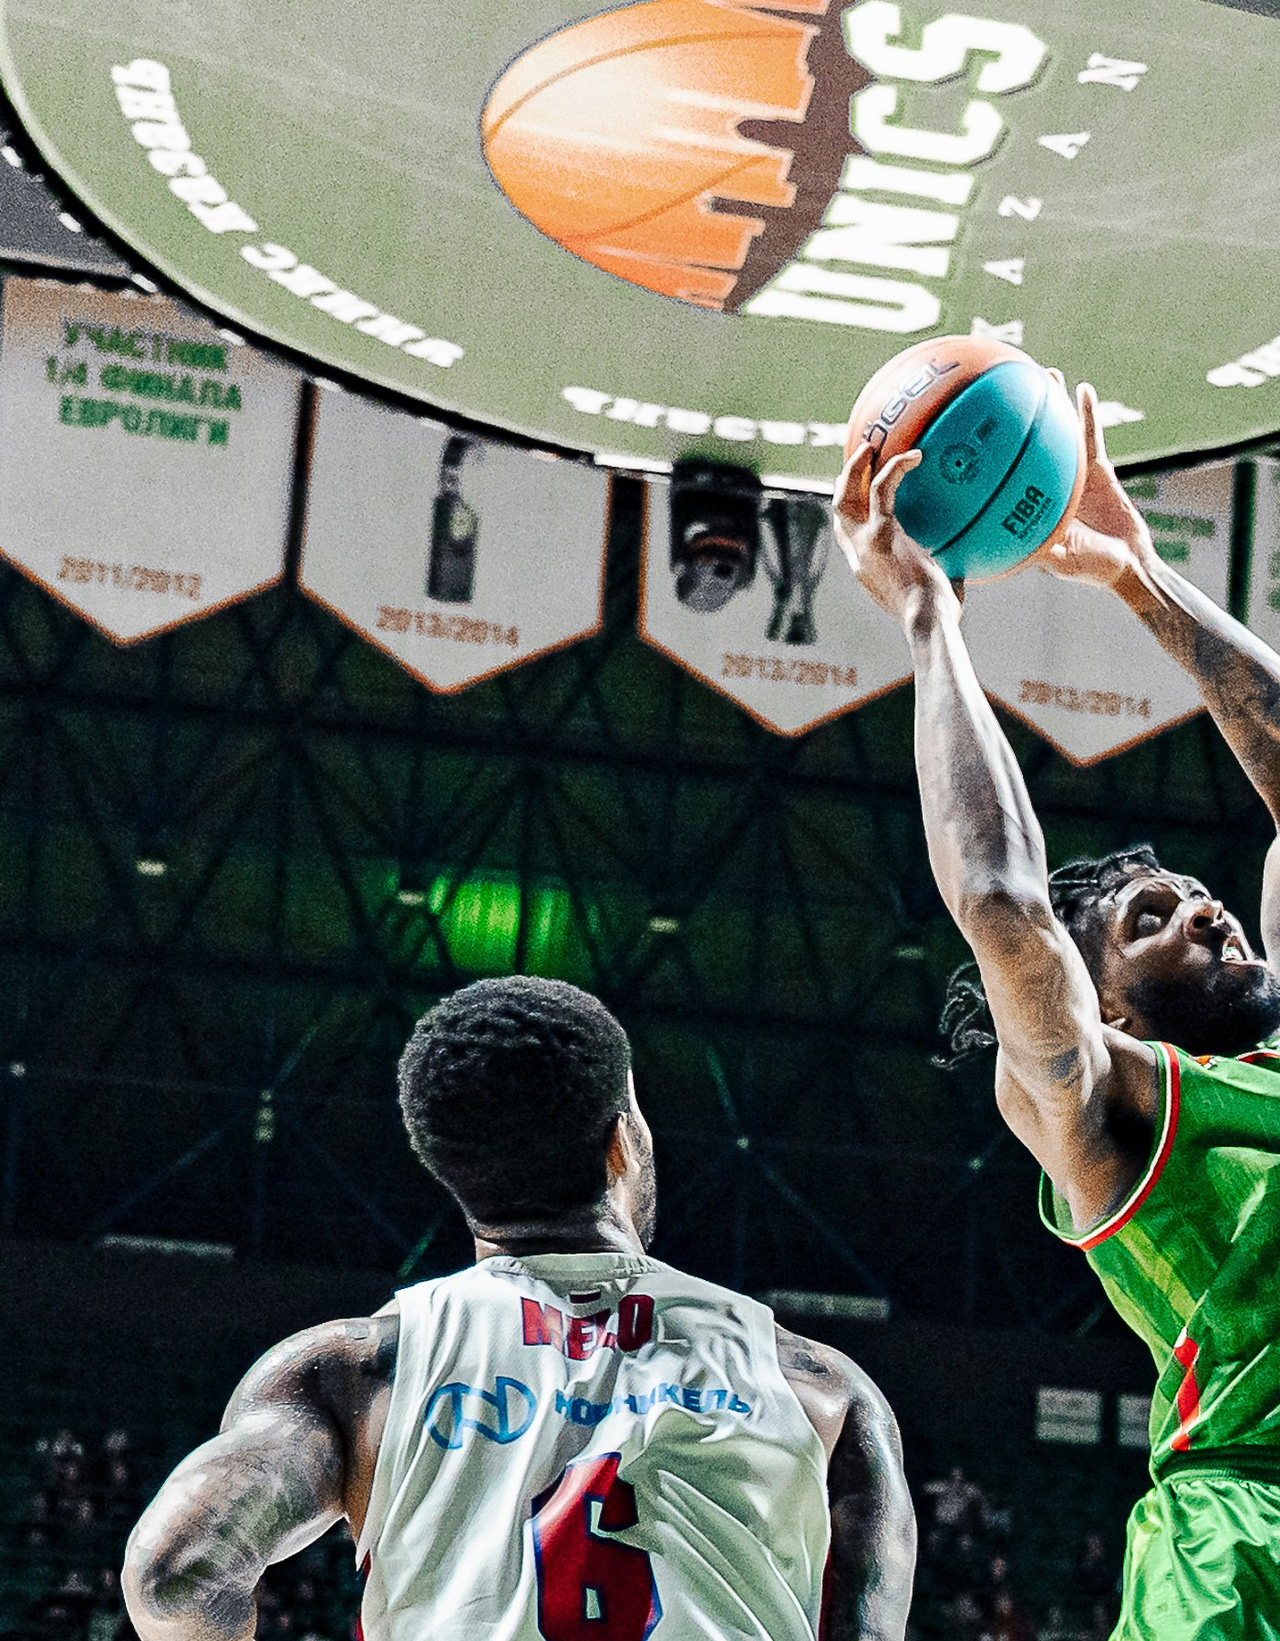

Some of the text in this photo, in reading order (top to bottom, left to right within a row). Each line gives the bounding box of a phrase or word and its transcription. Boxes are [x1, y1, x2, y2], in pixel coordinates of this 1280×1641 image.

[741, 0, 1050, 334] UNICS
[63, 318, 230, 371] УЧАСТНИК
[100, 362, 243, 412] ФИНАЛА
[58, 392, 230, 448] ЕВРОЛИГИ
[1001, 485, 1046, 537] FIBA
[519, 1289, 656, 1362] MEO
